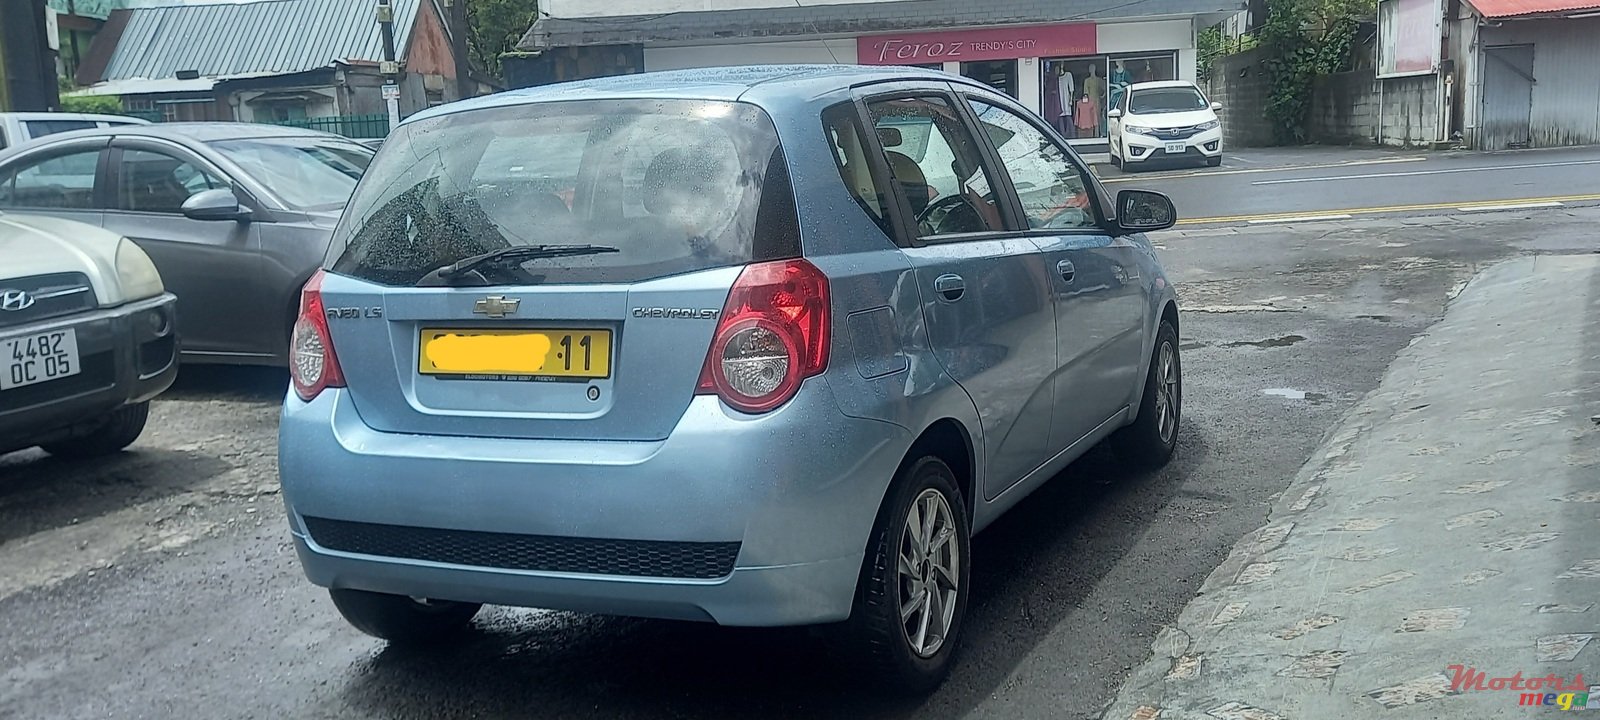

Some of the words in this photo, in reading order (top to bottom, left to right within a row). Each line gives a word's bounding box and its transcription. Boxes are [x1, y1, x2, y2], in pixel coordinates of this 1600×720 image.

[874, 39, 964, 62] Feroz
[970, 41, 1014, 51] TRENDY'S
[1016, 40, 1038, 49] CITY
[364, 306, 382, 318] LS
[632, 308, 719, 319] CHEVROLET
[12, 333, 64, 361] 4482
[45, 354, 70, 377] 05
